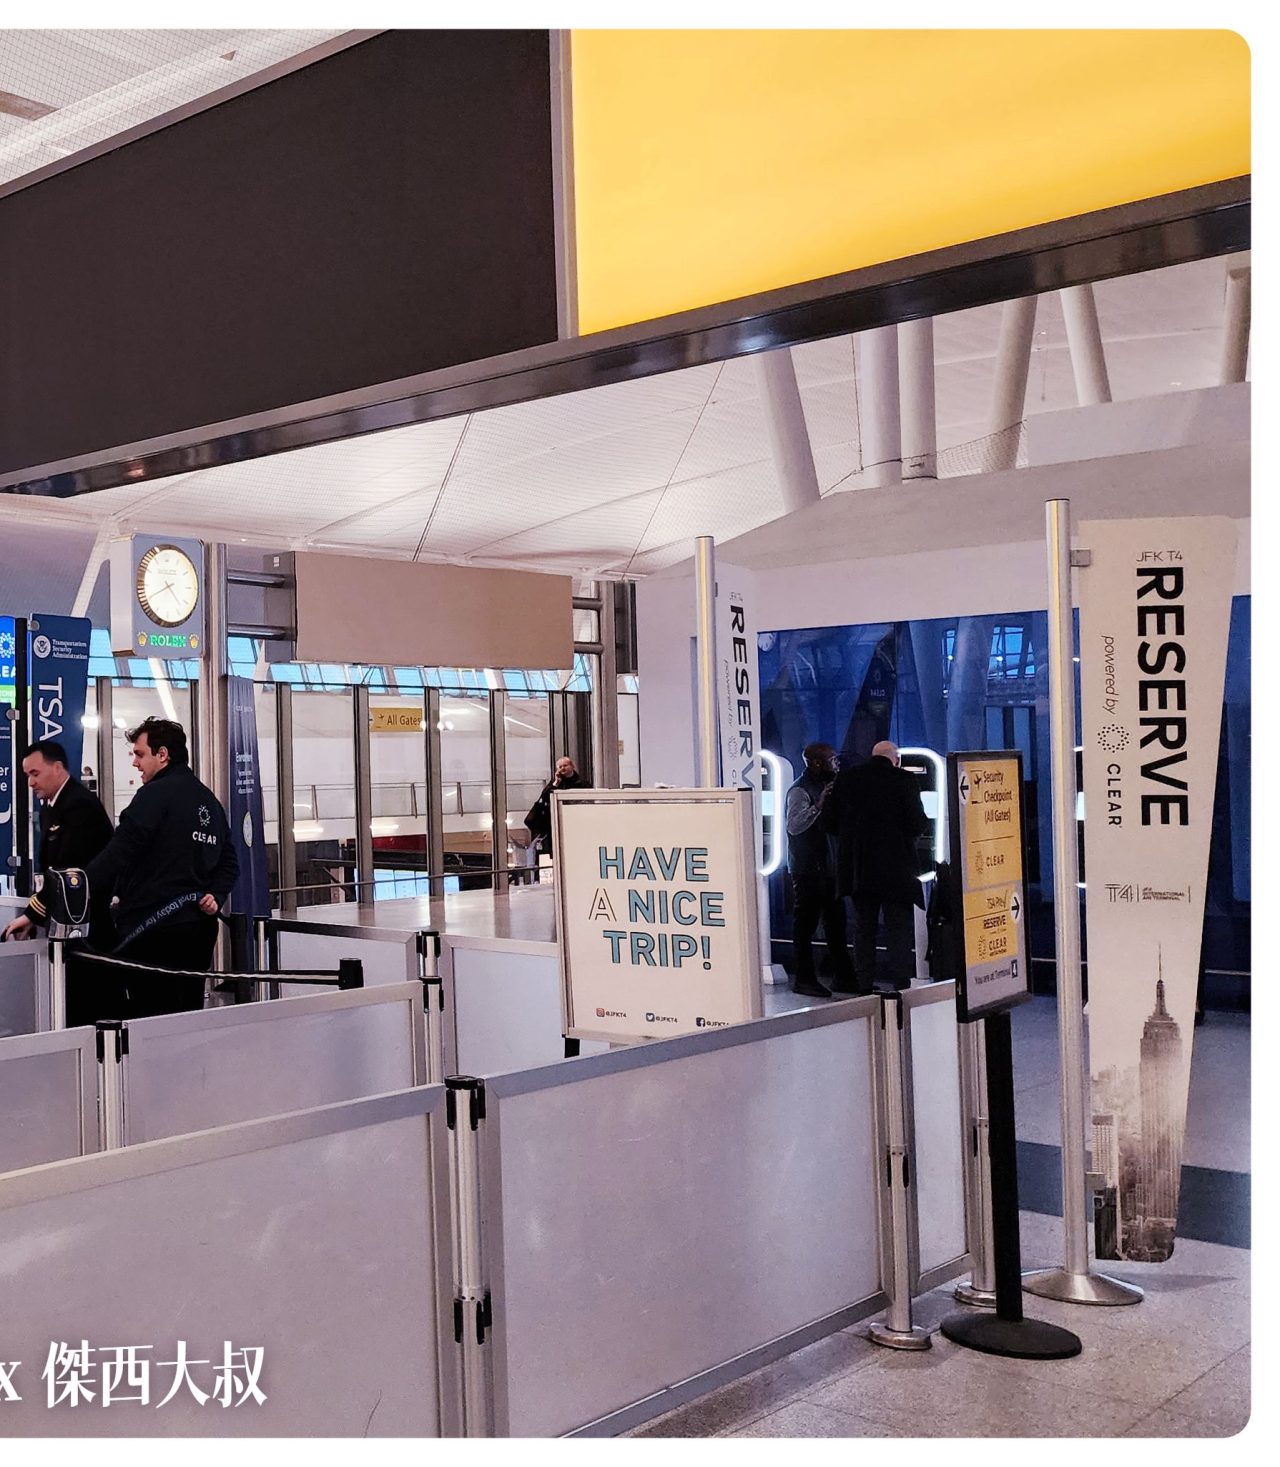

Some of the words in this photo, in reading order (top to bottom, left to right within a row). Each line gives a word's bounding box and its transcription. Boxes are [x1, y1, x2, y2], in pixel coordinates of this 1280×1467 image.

[1135, 551, 1164, 562] JFK
[1167, 550, 1183, 561] T4
[150, 634, 186, 648] ROLEX
[1102, 635, 1119, 695] powered
[730, 605, 756, 789] RESERV
[1136, 566, 1189, 827] RESERVE
[38, 676, 63, 741] TSA
[1102, 698, 1119, 715] by
[387, 714, 398, 726] All
[400, 715, 421, 726] Gates
[983, 770, 1004, 785] Security
[983, 789, 1013, 804] Checkpoint
[1106, 763, 1121, 827] CLEAR
[192, 831, 217, 845] CLEAR
[598, 846, 710, 882] HAVE
[986, 854, 1005, 867] CLEAR
[1104, 883, 1133, 902] T4
[156, 901, 180, 919] today
[588, 887, 617, 922] A
[628, 889, 726, 927] NICE
[145, 915, 157, 927] for
[603, 930, 712, 970] TRIP!
[988, 936, 1007, 951] CLEAR
